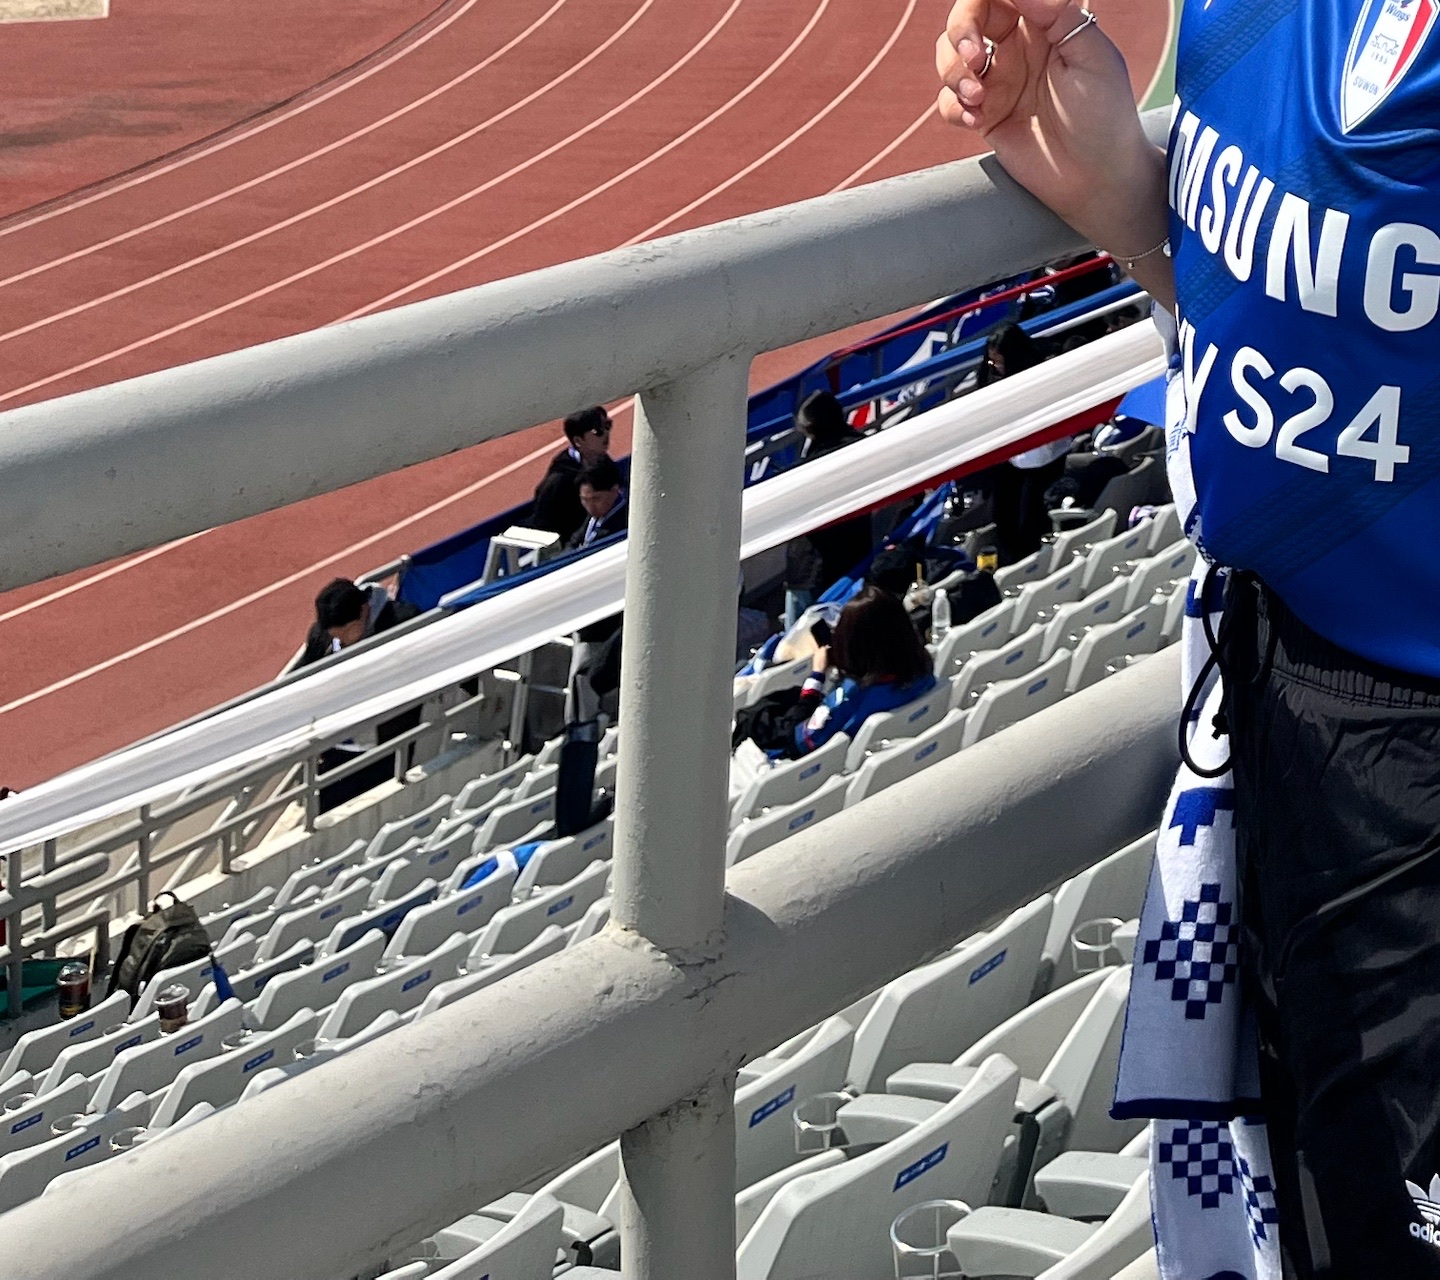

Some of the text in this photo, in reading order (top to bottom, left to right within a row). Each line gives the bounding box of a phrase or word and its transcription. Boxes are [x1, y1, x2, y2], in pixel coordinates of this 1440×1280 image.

[1385, 3, 1411, 22] Wings
[1352, 76, 1380, 96] SUWON
[1223, 345, 1411, 482] S24
